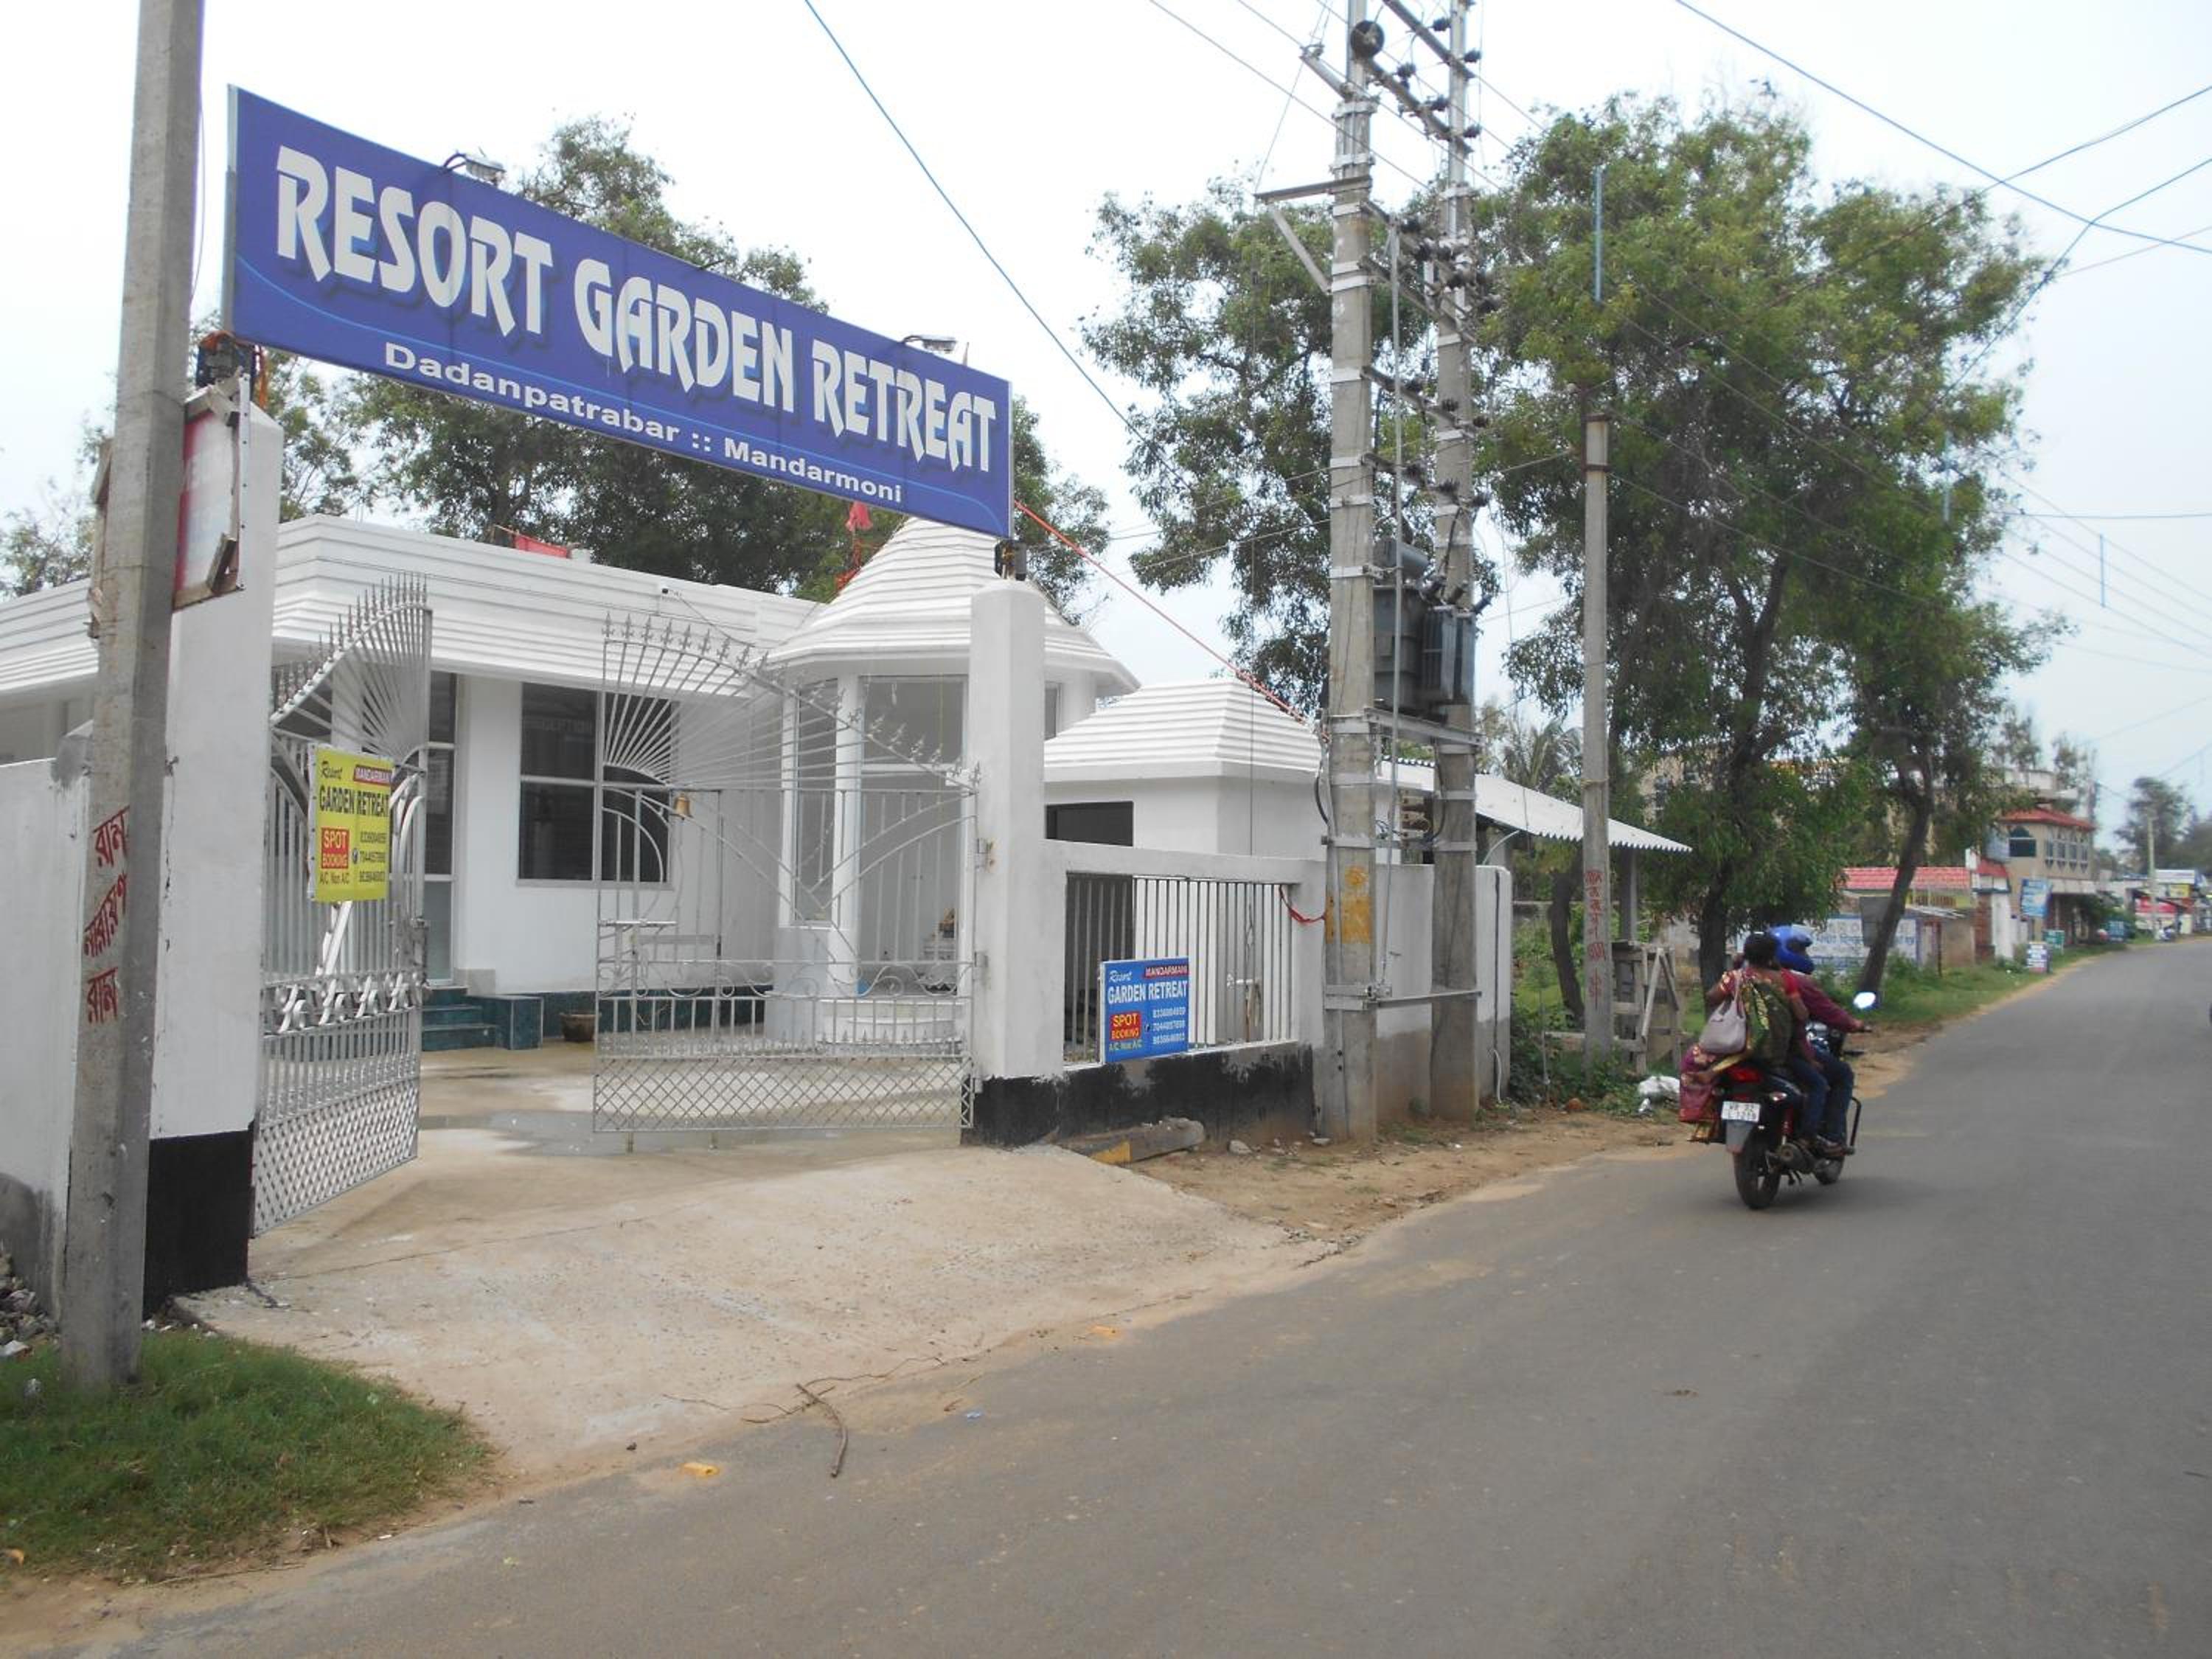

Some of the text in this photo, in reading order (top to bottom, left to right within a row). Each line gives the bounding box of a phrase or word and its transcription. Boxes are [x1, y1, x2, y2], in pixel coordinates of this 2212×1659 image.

[276, 145, 997, 472] RESORT GARDEN RETREAT
[385, 342, 680, 442] Dadanpatrabar
[724, 437, 902, 504] Mandarmoni
[319, 785, 389, 817] GARDEN RETREAT
[324, 830, 347, 849] SPOT
[322, 853, 348, 868] BOOKING
[1108, 980, 1188, 1004] GARDEN RETREAT
[1113, 1013, 1138, 1027] SPOT
[1111, 1028, 1139, 1040] BOOKING
